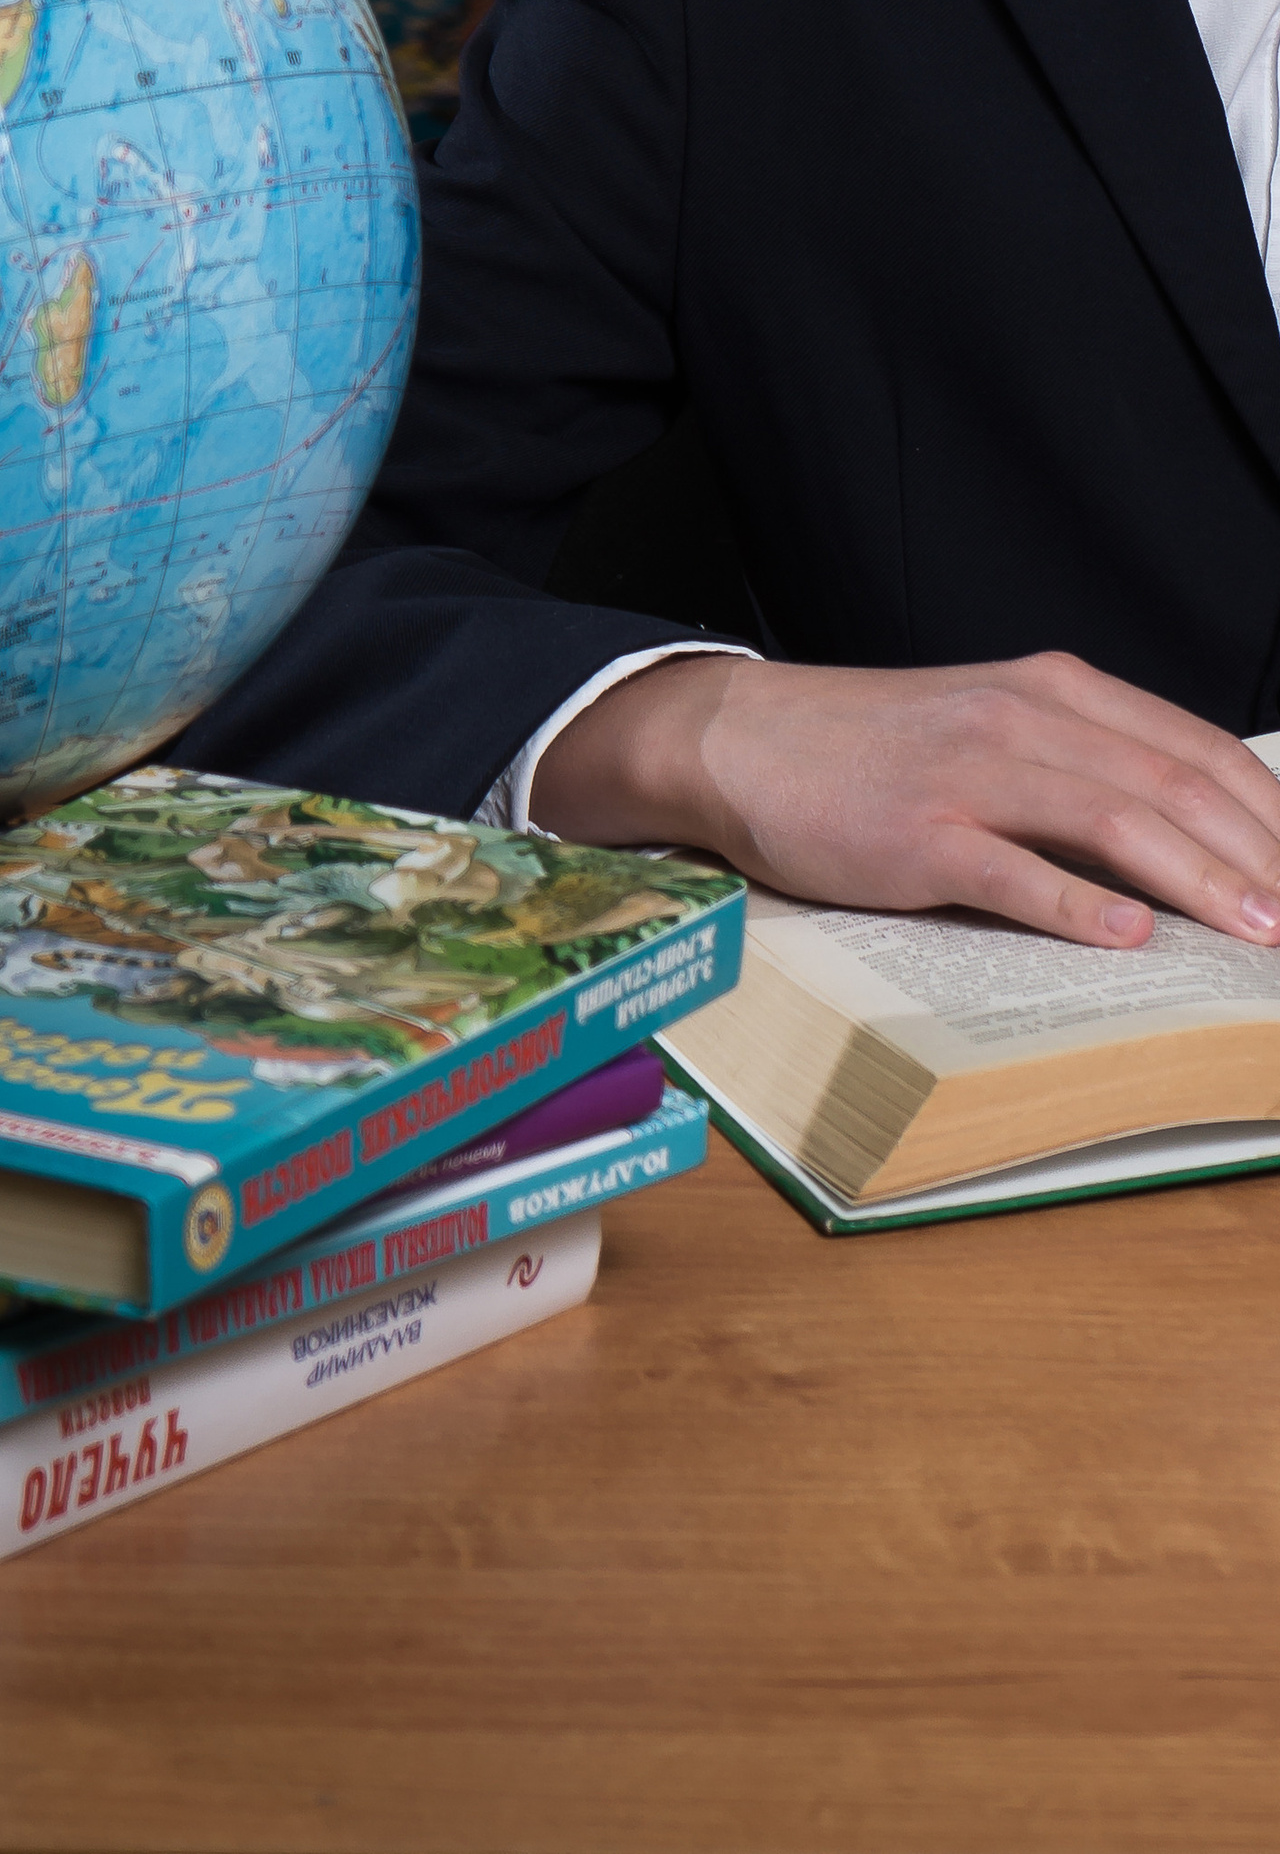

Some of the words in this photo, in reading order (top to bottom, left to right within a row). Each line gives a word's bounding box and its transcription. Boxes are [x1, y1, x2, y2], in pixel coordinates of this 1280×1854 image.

[359, 1011, 568, 1162] ДОИСТОРИЧЕСКИЕ
[242, 1128, 354, 1229] ПОВЕСТИ
[507, 1146, 670, 1225] Ю.ДРУЖКОВ
[309, 1239, 378, 1304] ШКОЛА
[384, 1201, 490, 1277] ВОЛШЕБНАЯ
[184, 1264, 305, 1347] КАРАНДАША
[291, 1279, 438, 1364] ЖЕЛЕЗНИКОВ
[306, 1318, 422, 1391] ВЛАДИМИР
[57, 1376, 152, 1442] ПОВЕСТИ
[19, 1407, 189, 1535] ЧУЧЕЛО
